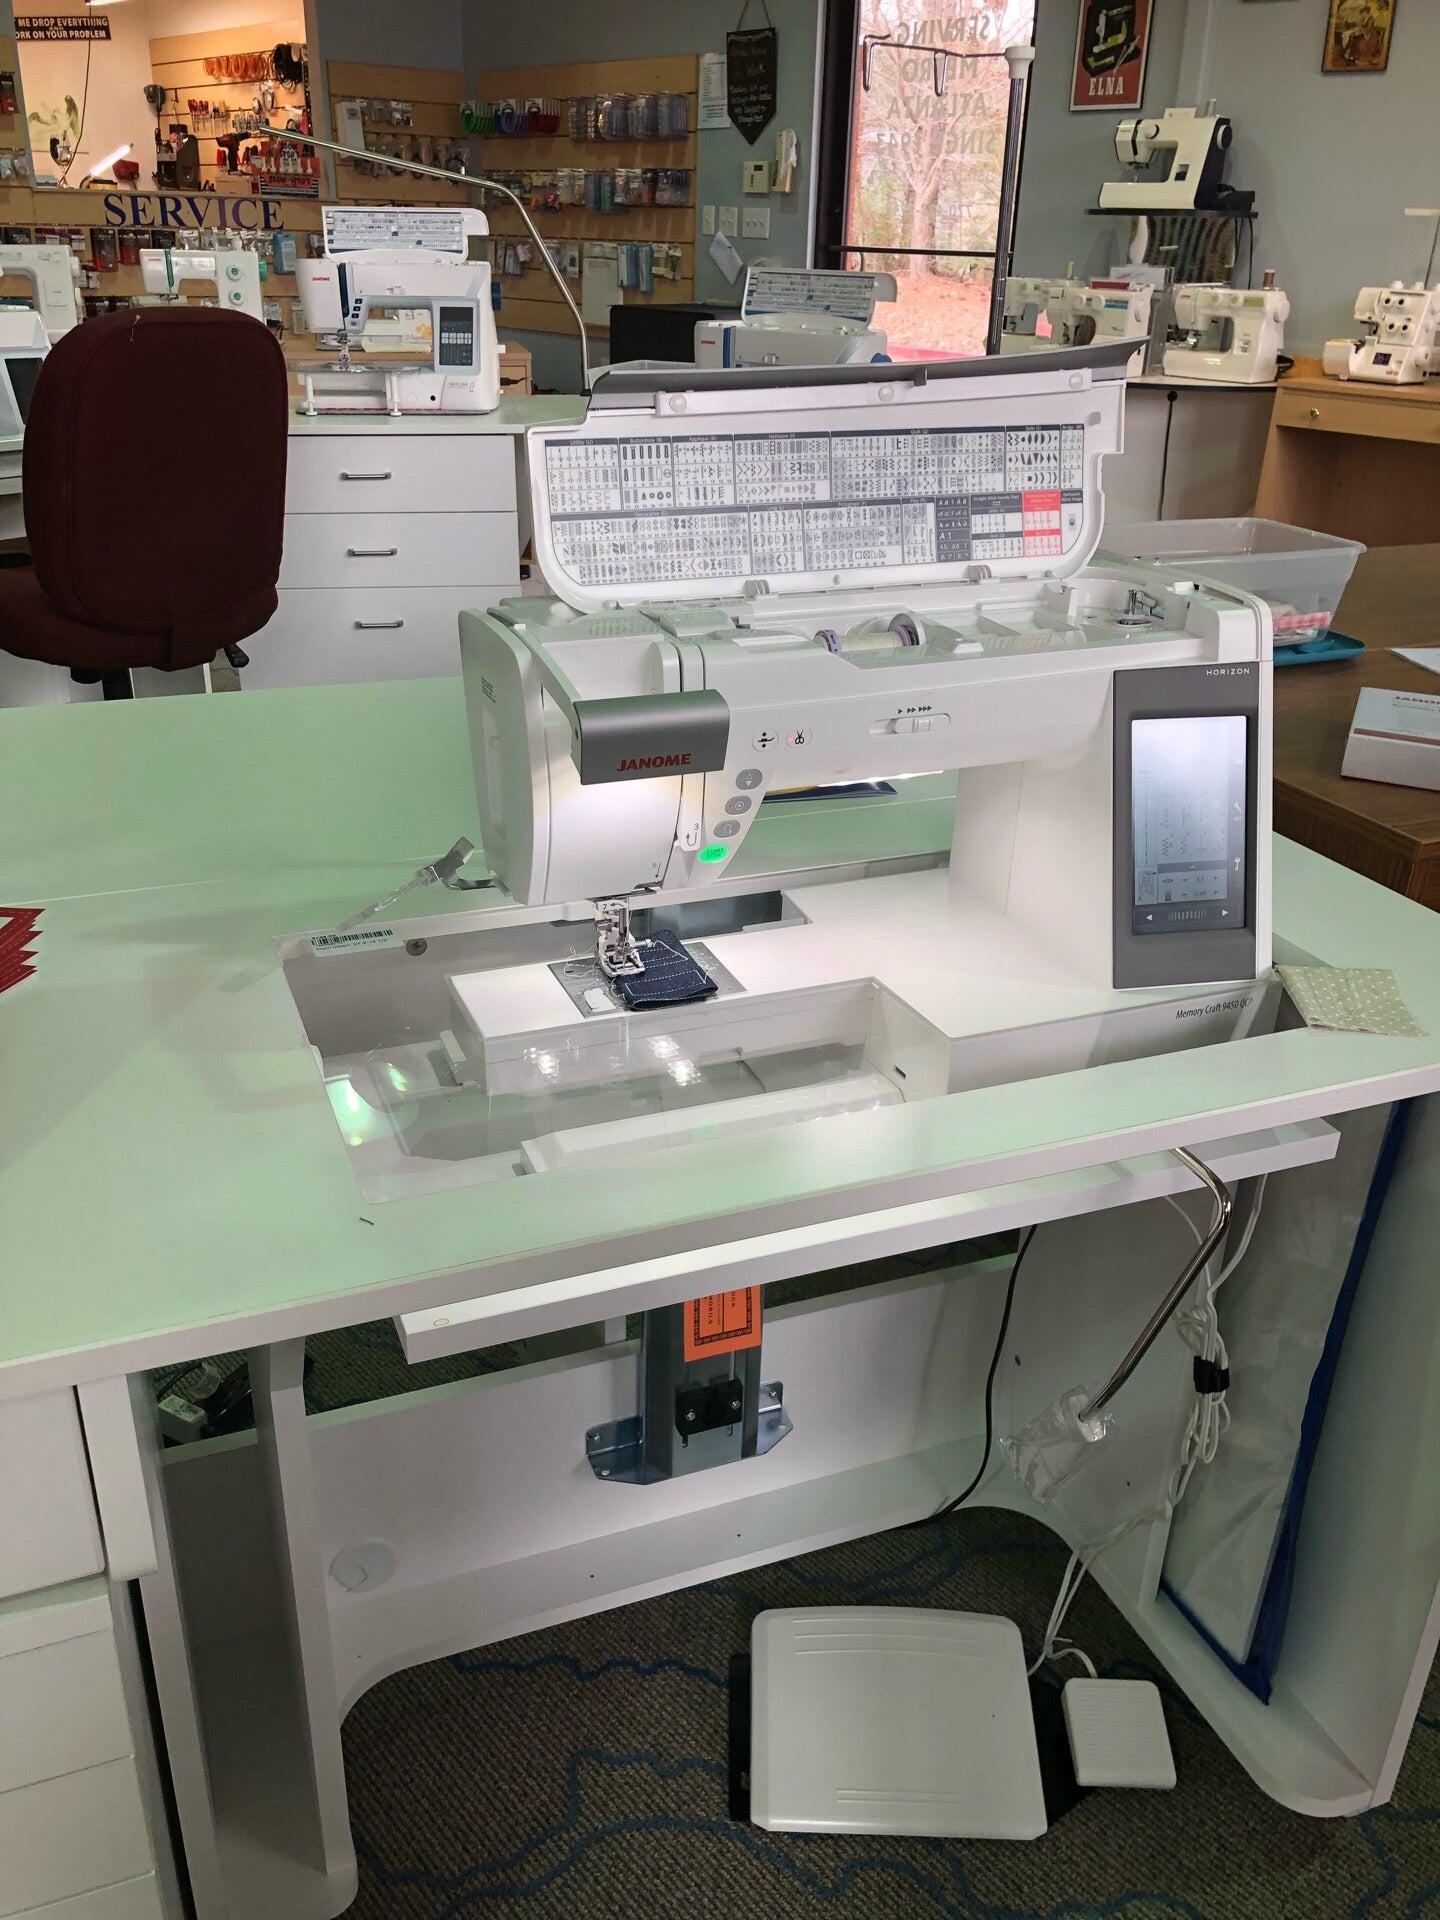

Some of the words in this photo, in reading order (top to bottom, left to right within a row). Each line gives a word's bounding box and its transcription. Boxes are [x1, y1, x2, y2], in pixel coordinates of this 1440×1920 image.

[18, 17, 31, 27] ME
[32, 17, 55, 27] DROP
[56, 17, 108, 27] EVERYTHING
[15, 31, 31, 39] ORK
[32, 31, 45, 39] ON
[46, 30, 68, 39] YOUR
[69, 30, 107, 39] PROBLEM
[1088, 76, 1124, 96] ELNA
[103, 193, 284, 230] SERVICE
[1206, 667, 1250, 676] HORIZON
[616, 753, 692, 772] JANOME
[693, 823, 699, 831] 3
[1175, 1008, 1204, 1019] Memory
[1204, 1002, 1221, 1014] Craft
[1222, 1000, 1239, 1012] 9450
